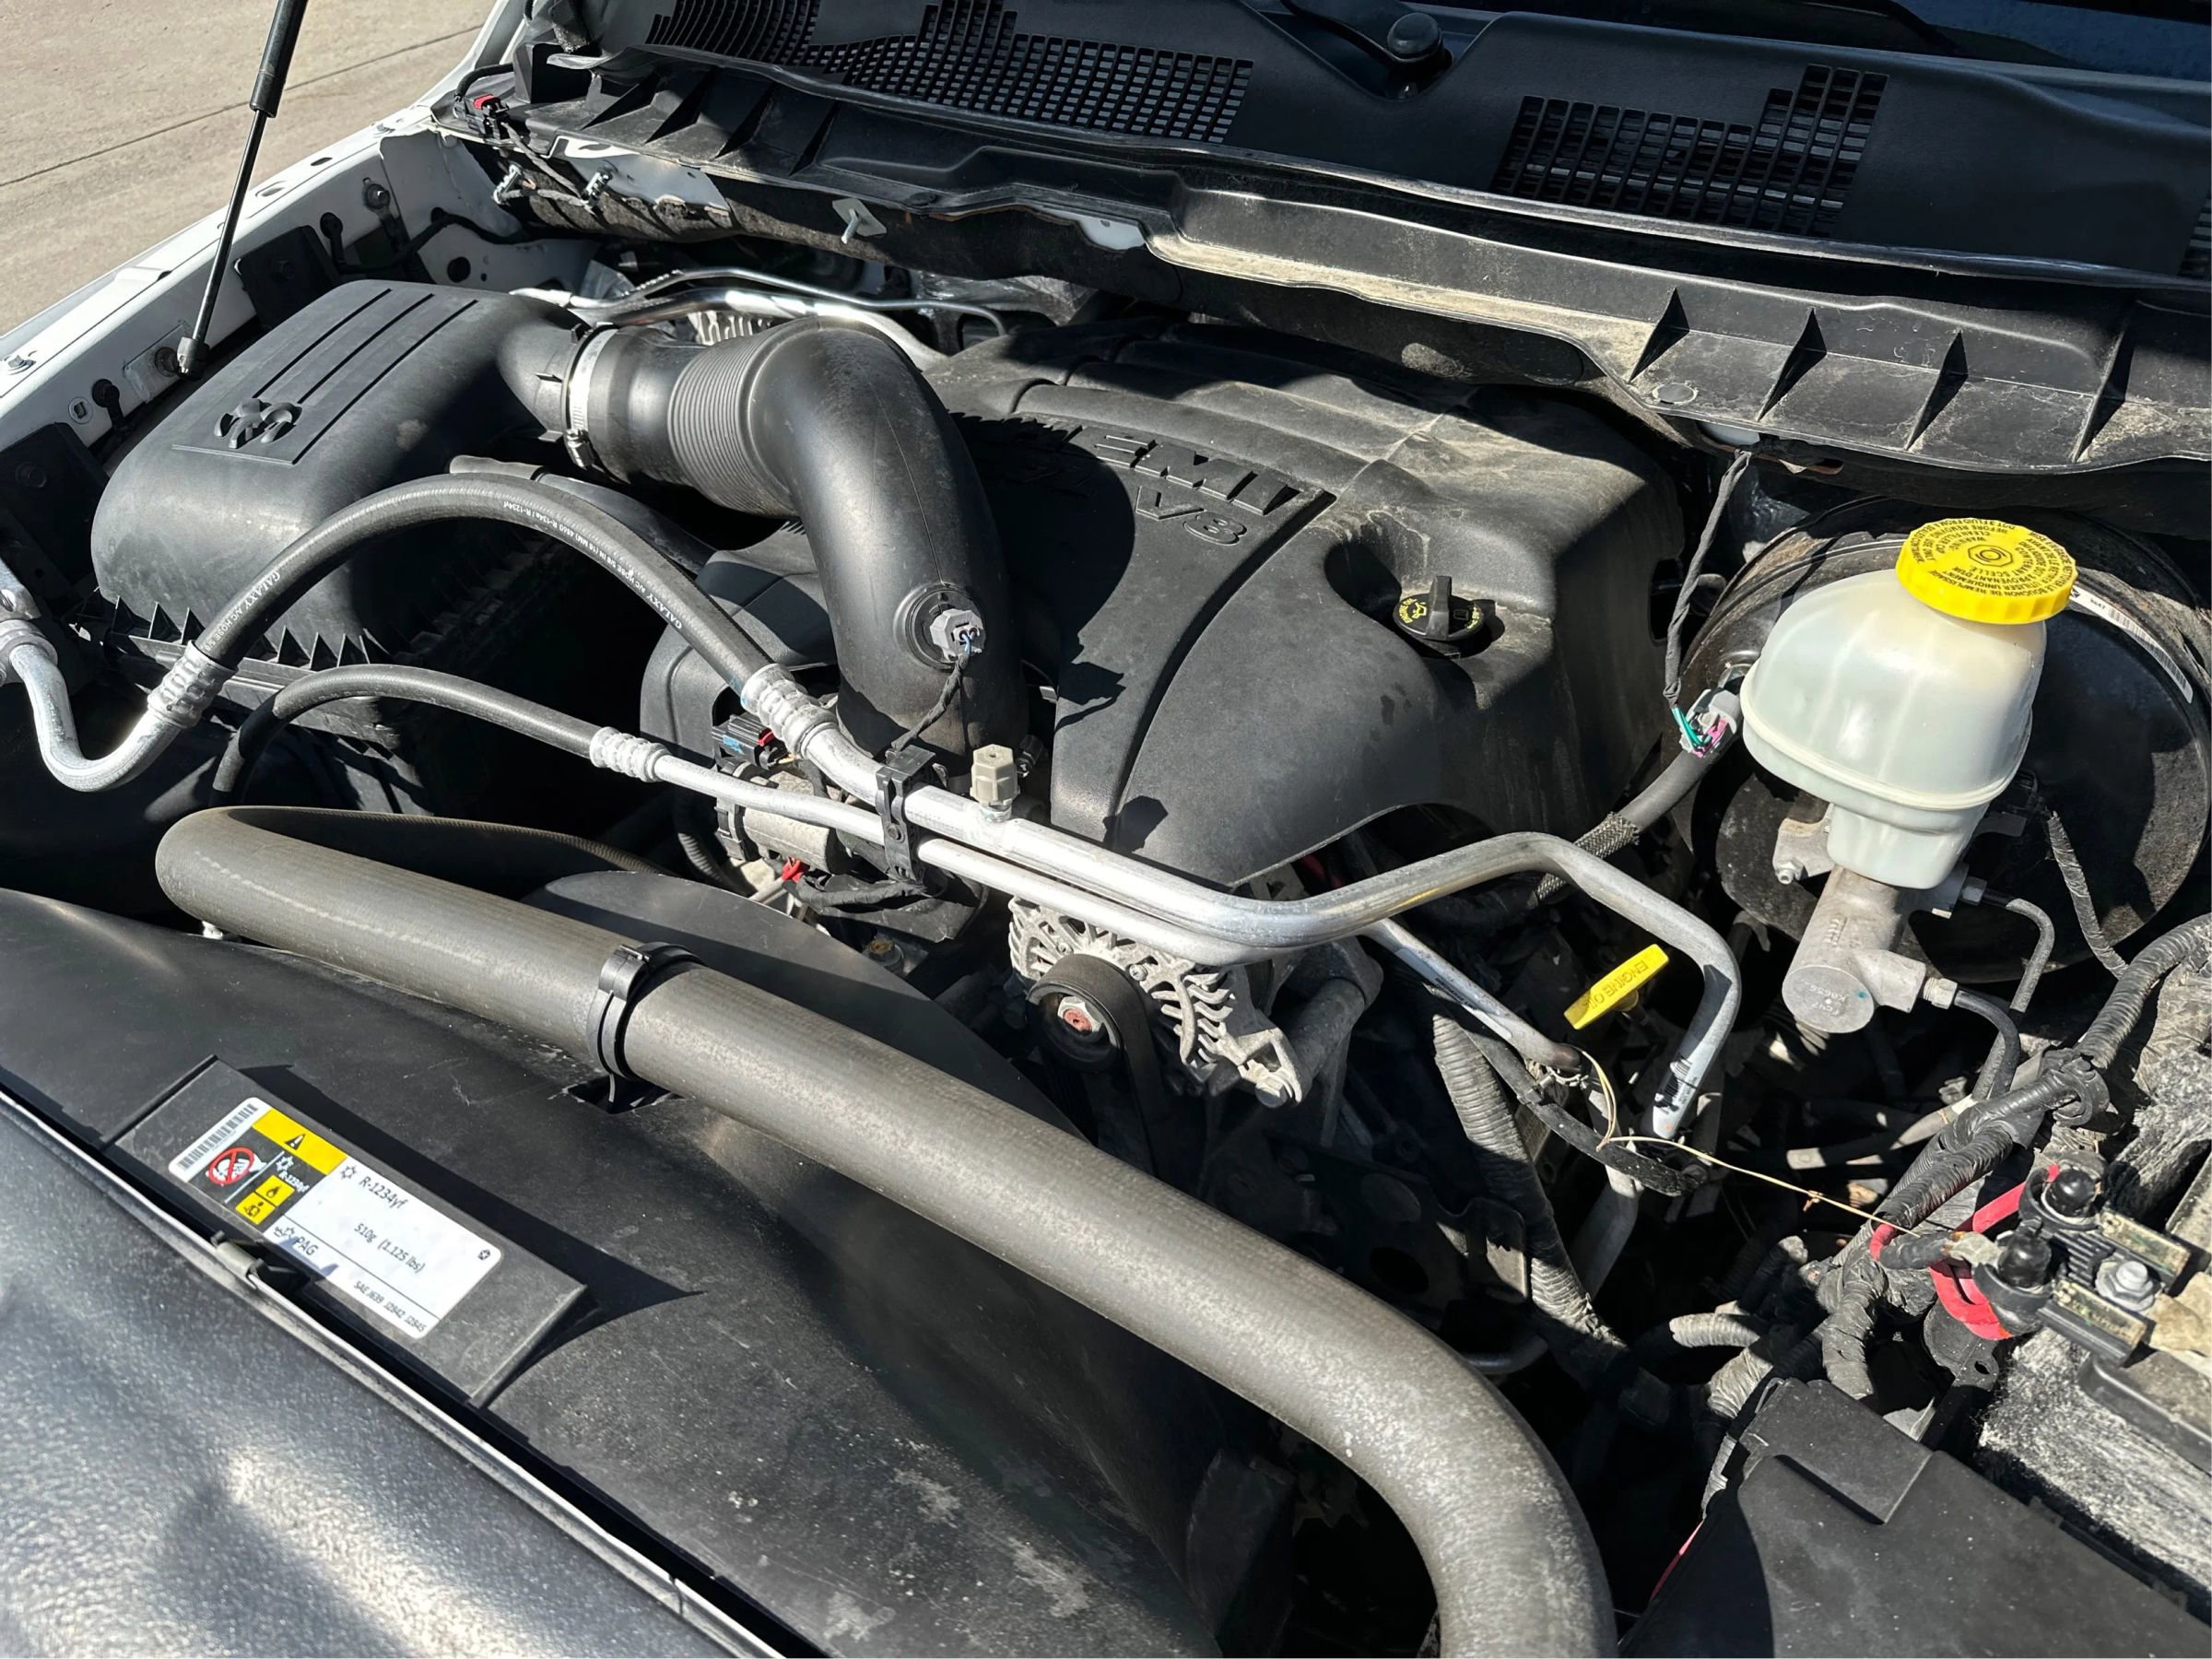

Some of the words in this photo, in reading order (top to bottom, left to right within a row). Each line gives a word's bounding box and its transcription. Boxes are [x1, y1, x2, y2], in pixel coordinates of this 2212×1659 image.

[1018, 420, 1300, 515] EMI
[1135, 486, 1247, 546] V8
[618, 564, 635, 583] HOSE
[635, 581, 646, 594] A/C
[1941, 570, 2001, 589] UNIQUEMENT
[243, 571, 281, 610] GALAXY
[231, 606, 243, 621] A/C
[646, 593, 682, 629] GALAXY
[213, 618, 233, 641] HOSE
[1602, 959, 1649, 997] ENGINE
[1583, 993, 1606, 1009] OIL
[278, 1171, 310, 1194] R-1234yf
[359, 1175, 408, 1209] R-1234yf
[295, 1236, 319, 1256] PAG
[354, 1222, 377, 1243] 510g
[377, 1238, 409, 1262] (1.125
[406, 1256, 426, 1274] lbs)
[354, 1280, 371, 1295] SAE
[383, 1300, 406, 1318] J2842
[404, 1315, 428, 1333] J2845
